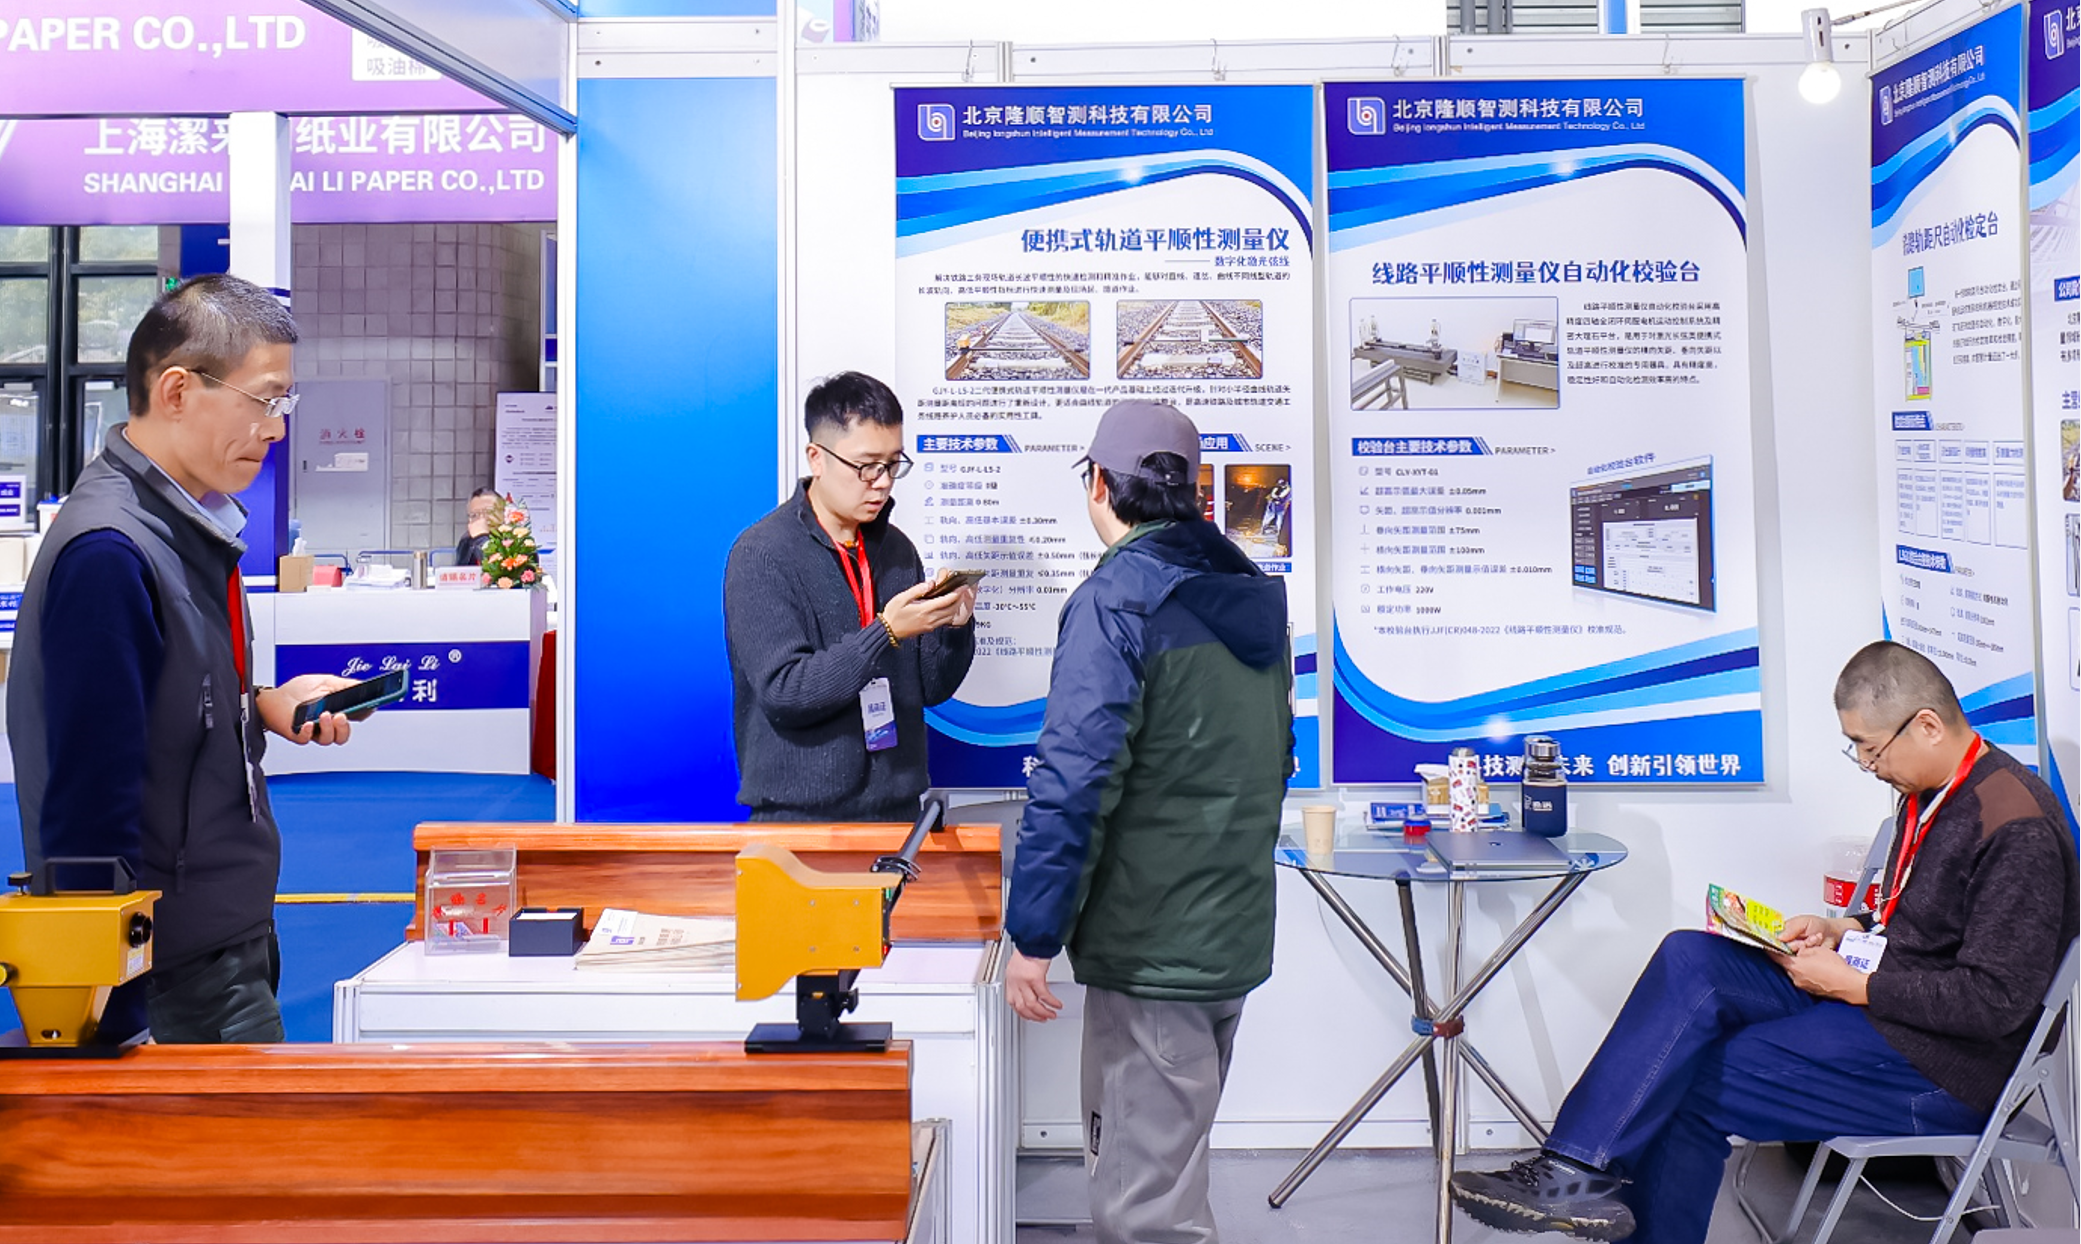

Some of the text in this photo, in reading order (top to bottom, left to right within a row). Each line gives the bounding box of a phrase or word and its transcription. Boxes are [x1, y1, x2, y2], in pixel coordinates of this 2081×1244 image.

[132, 15, 307, 58] CO.,LTD
[962, 104, 1213, 126] 北京隆顺智测科技有限公司
[1393, 98, 1644, 119] 北京隆顺智测科技有限公司
[83, 169, 545, 196] SHANGHAI AI LI PAPER CO.,LTD
[1021, 227, 1290, 253] 便携式轨道平顺性测量仪
[1372, 259, 1701, 285] 线路平顺性测量仪自动化校验台
[923, 437, 998, 451] 主要技术参数
[1200, 436, 1284, 452] 应用 SCENE
[1358, 440, 1549, 455] 校验台主要技术参数 PARAMETER
[1607, 754, 1742, 777] 创新引领世界
